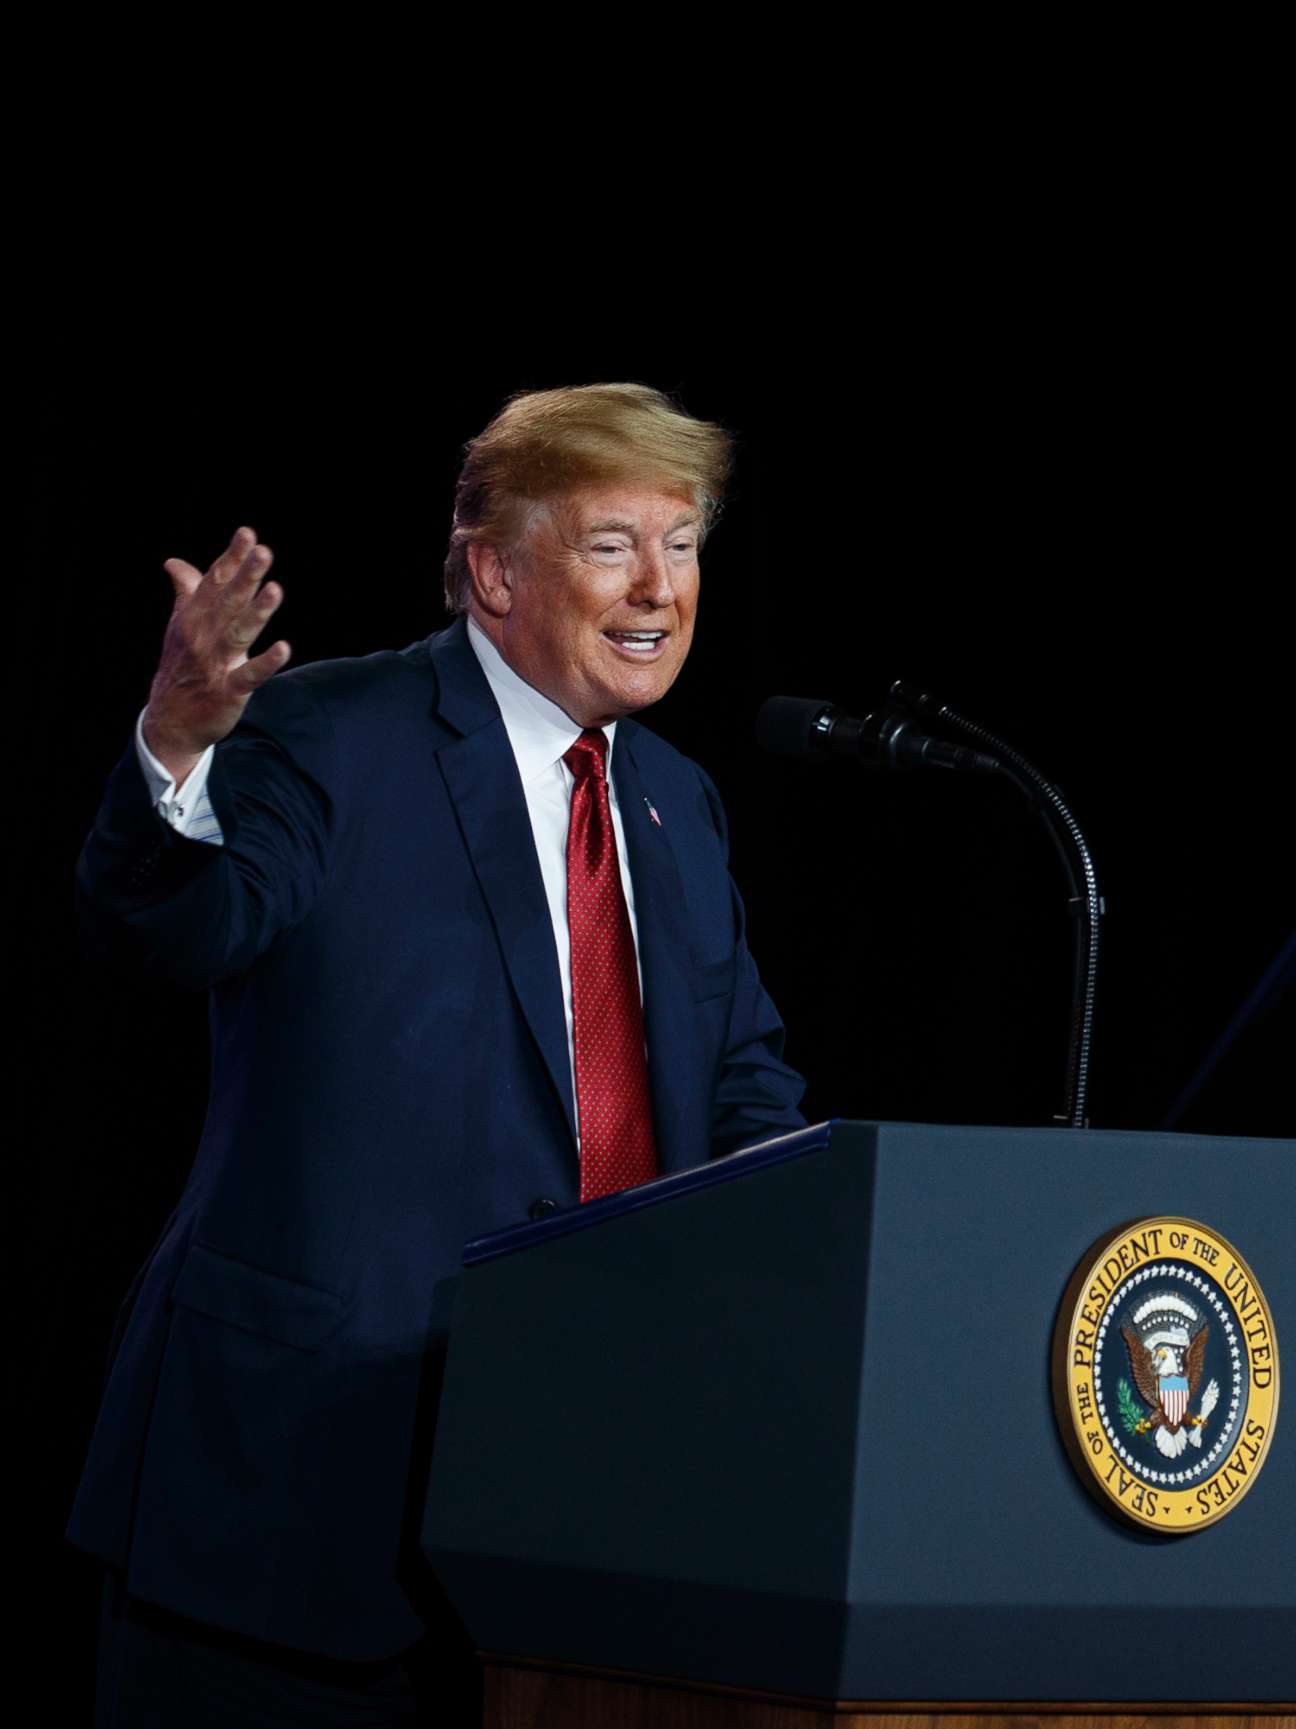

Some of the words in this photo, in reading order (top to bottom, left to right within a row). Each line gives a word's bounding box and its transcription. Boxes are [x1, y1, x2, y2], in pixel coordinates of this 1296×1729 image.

[1169, 1231, 1190, 1250] OF
[1192, 1237, 1220, 1267] THE
[1074, 1229, 1163, 1369] PRESIDENT
[1223, 1262, 1272, 1389] UNITED
[1076, 1382, 1094, 1425] THE
[1087, 1430, 1103, 1455] OF
[1196, 1419, 1265, 1516] STATES
[1104, 1454, 1159, 1517] SEAL
